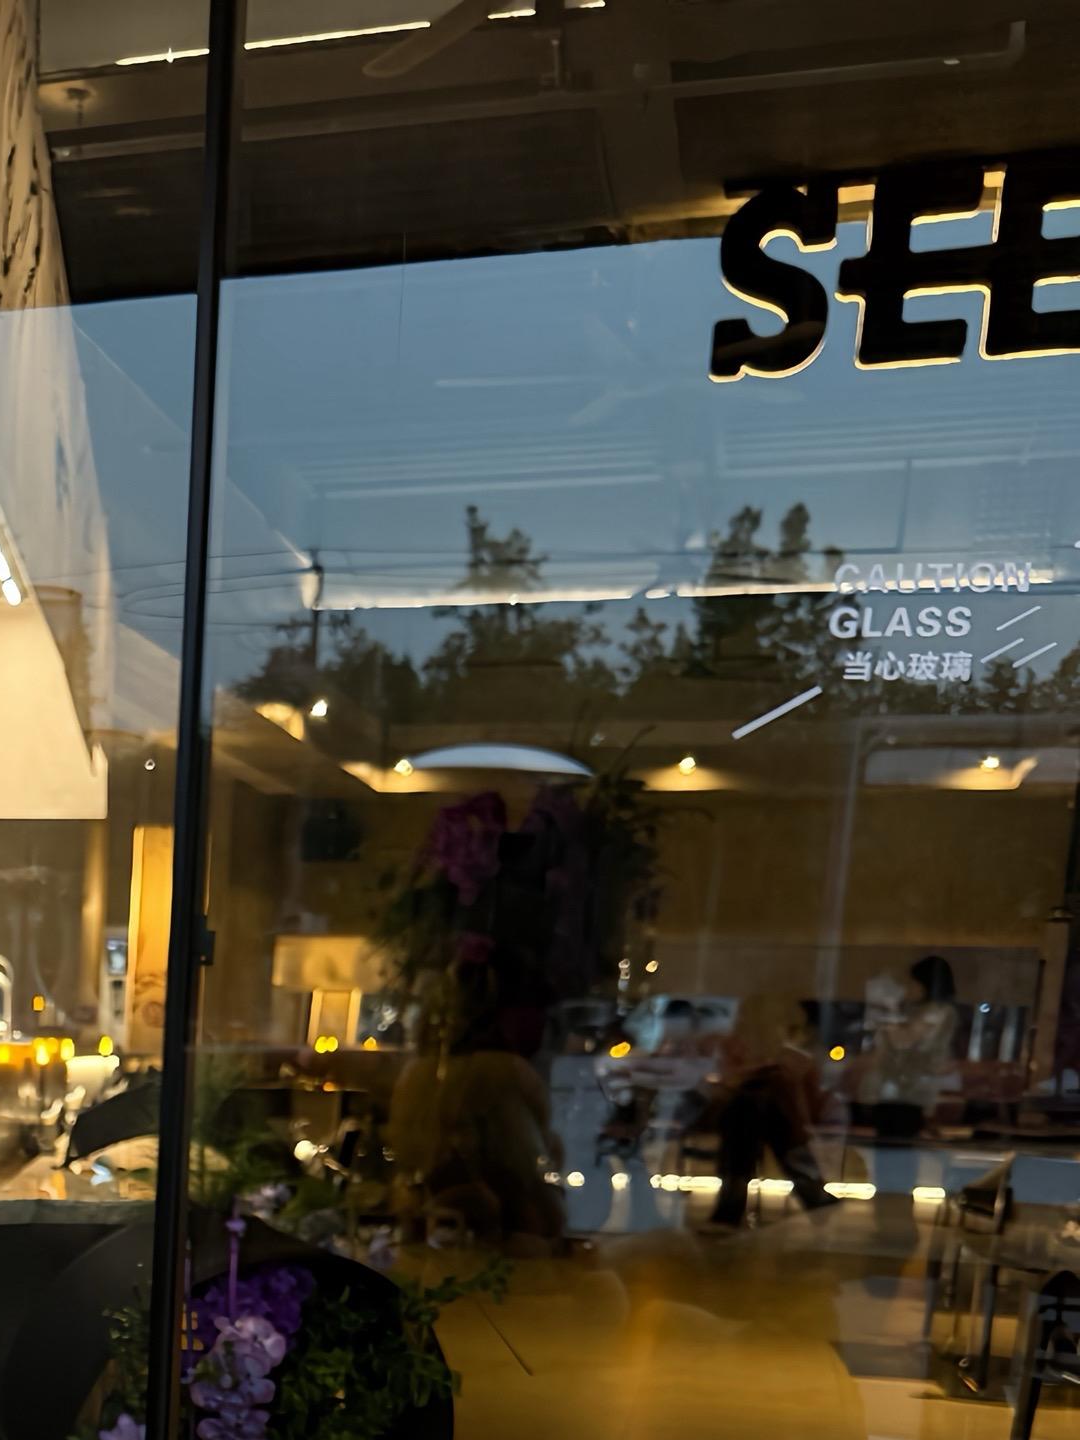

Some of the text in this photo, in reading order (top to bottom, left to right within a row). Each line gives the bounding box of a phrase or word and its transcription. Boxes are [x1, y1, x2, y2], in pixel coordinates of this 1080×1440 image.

[834, 562, 1033, 594] CAUTION
[829, 606, 972, 639] GLASS
[843, 651, 973, 682] 当心玻璃
